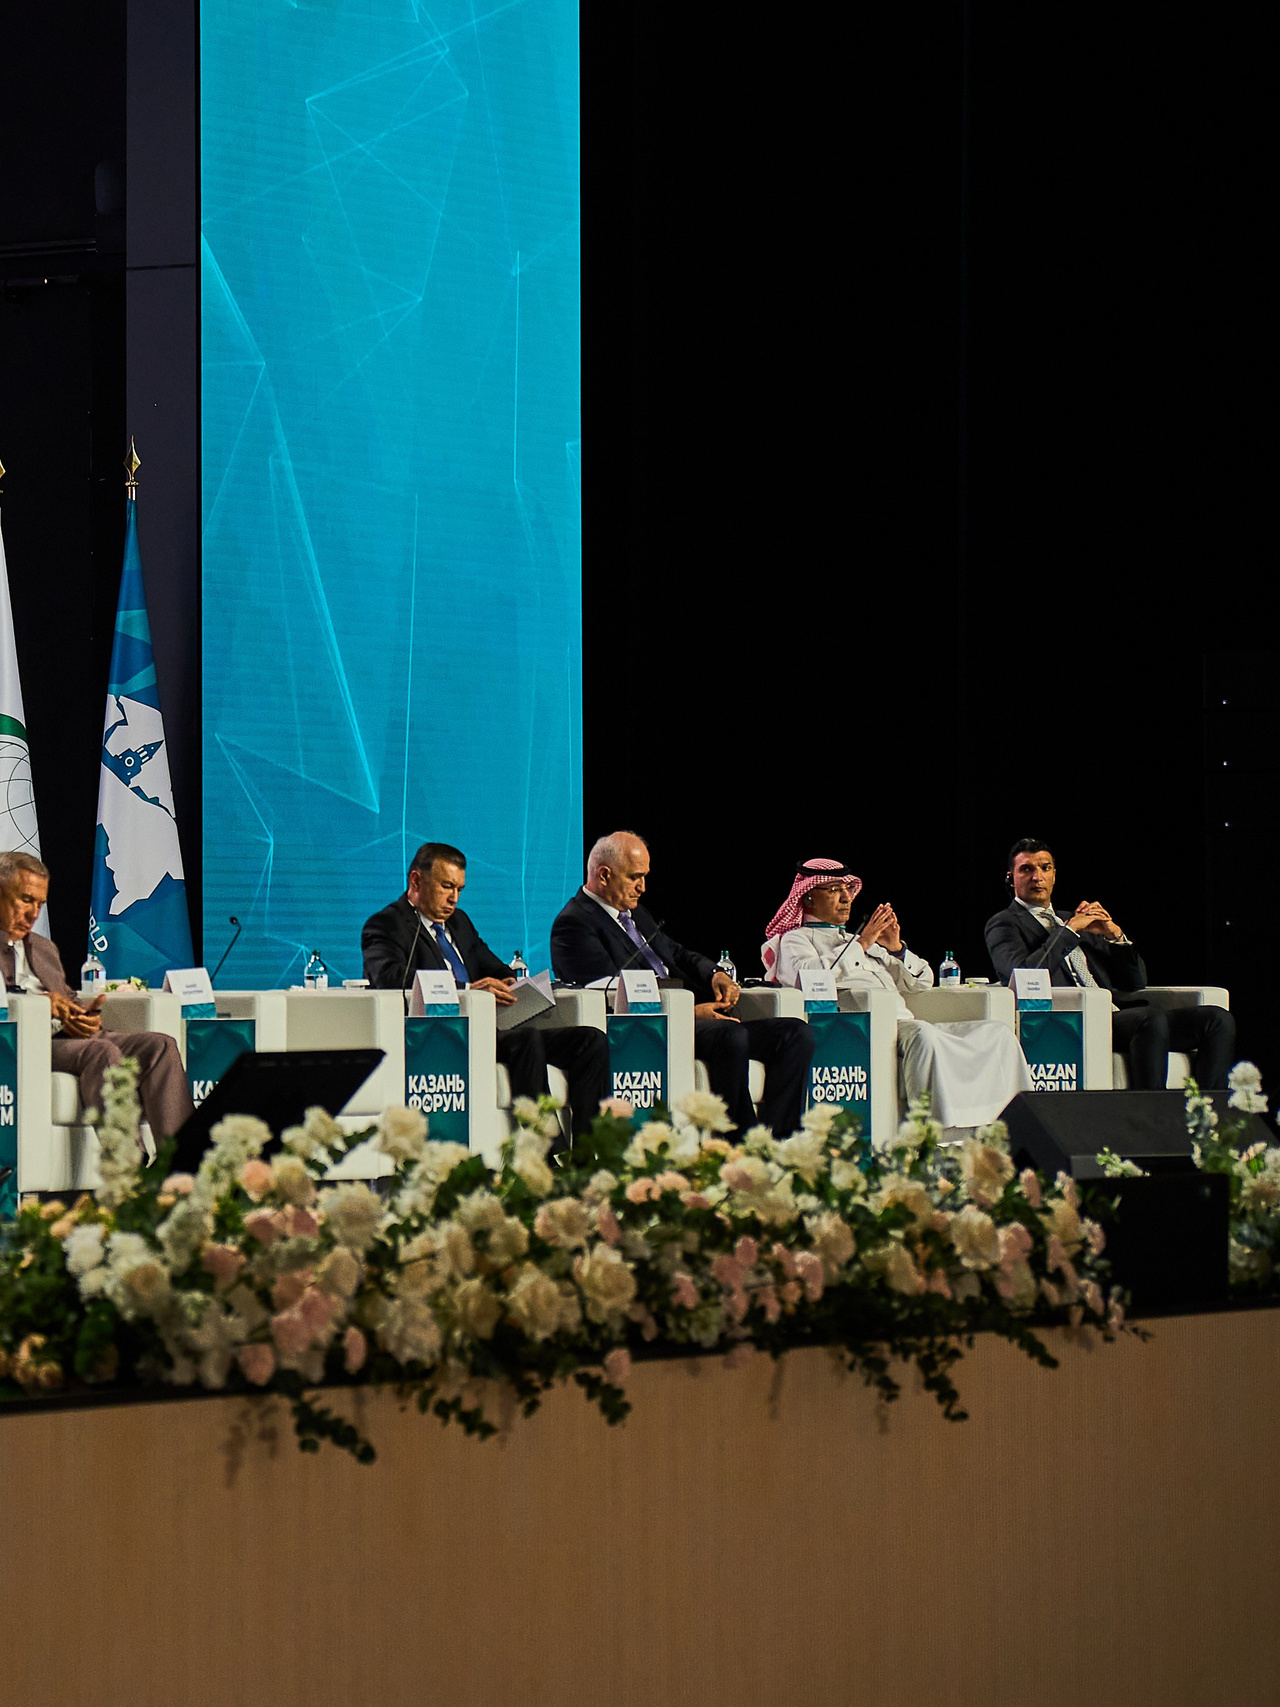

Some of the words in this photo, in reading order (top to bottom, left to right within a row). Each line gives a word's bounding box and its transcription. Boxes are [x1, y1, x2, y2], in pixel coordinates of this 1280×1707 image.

[613, 1071, 661, 1090] KAZAN
[812, 1066, 867, 1084] КАЗАНЬ
[1028, 1063, 1076, 1080] KAZAN
[409, 1074, 465, 1093] КАЗАНЬ
[408, 1093, 465, 1113] ФОРУМ
[812, 1084, 867, 1103] ФОРУМ
